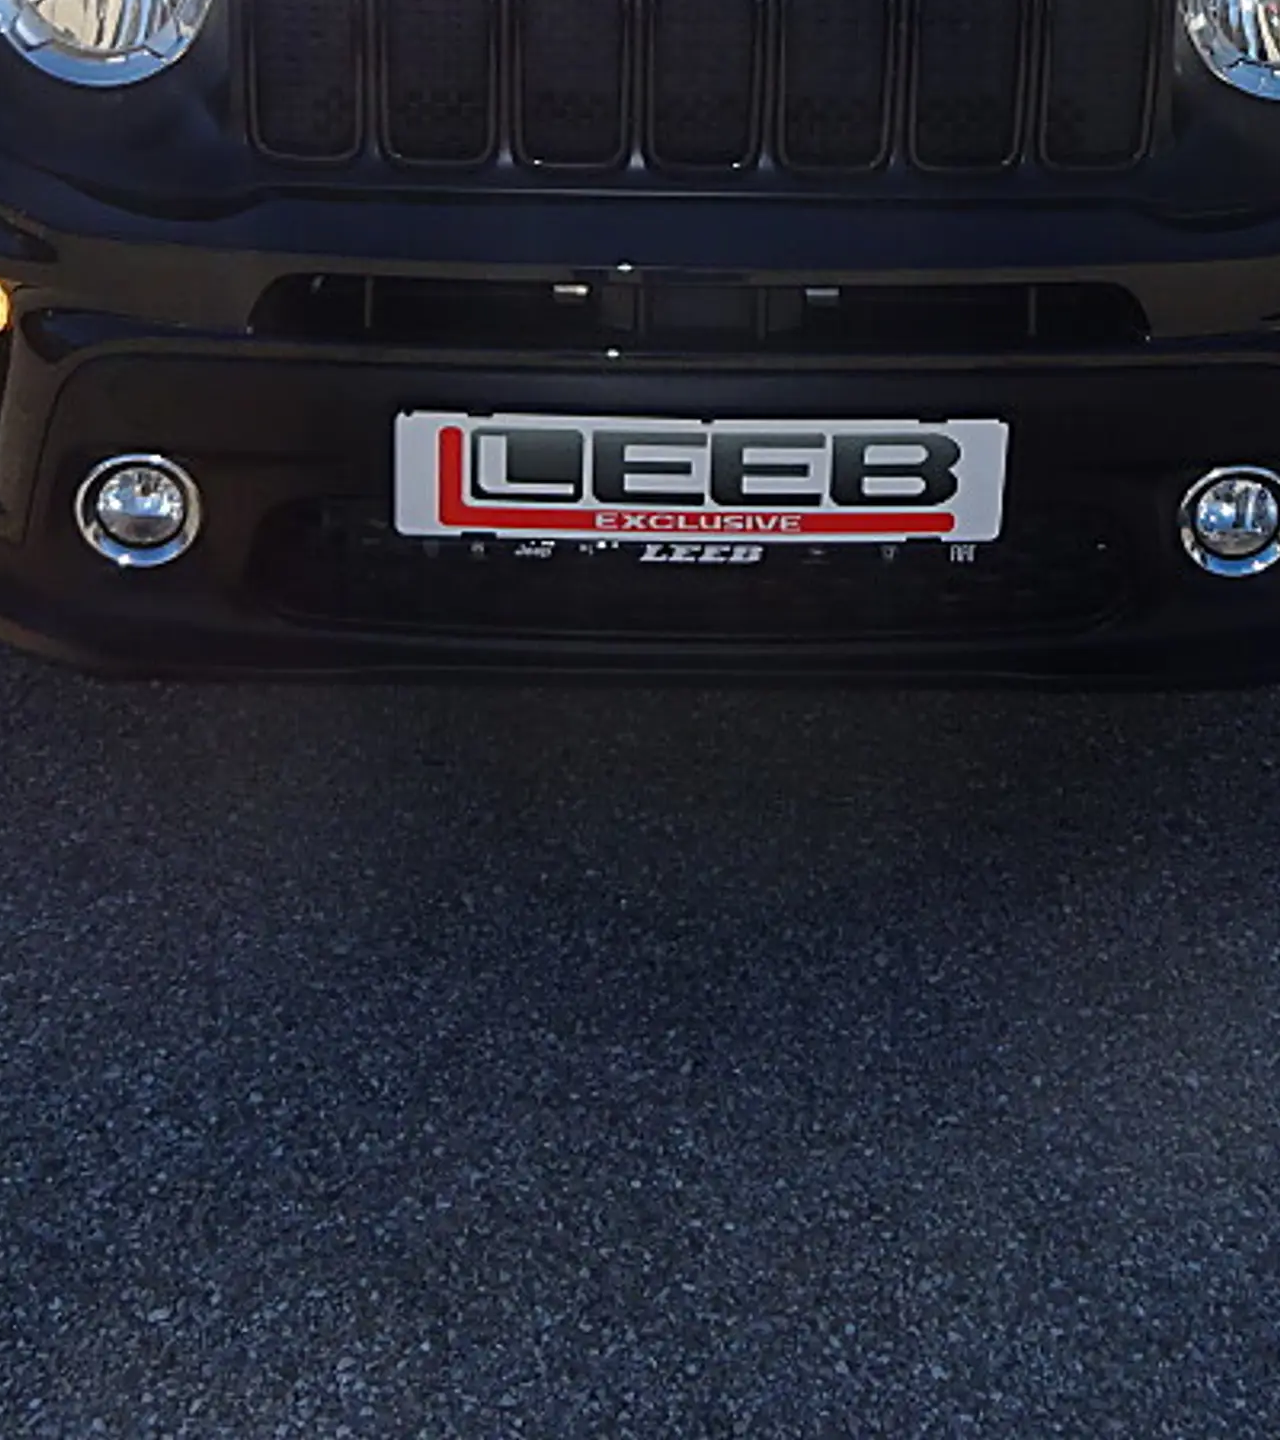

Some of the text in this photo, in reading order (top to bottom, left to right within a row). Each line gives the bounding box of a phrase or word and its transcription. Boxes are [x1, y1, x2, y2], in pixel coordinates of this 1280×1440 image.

[470, 426, 962, 508] LEEB
[594, 511, 802, 533] EXCLUSIVE
[640, 543, 764, 563] LEEB
